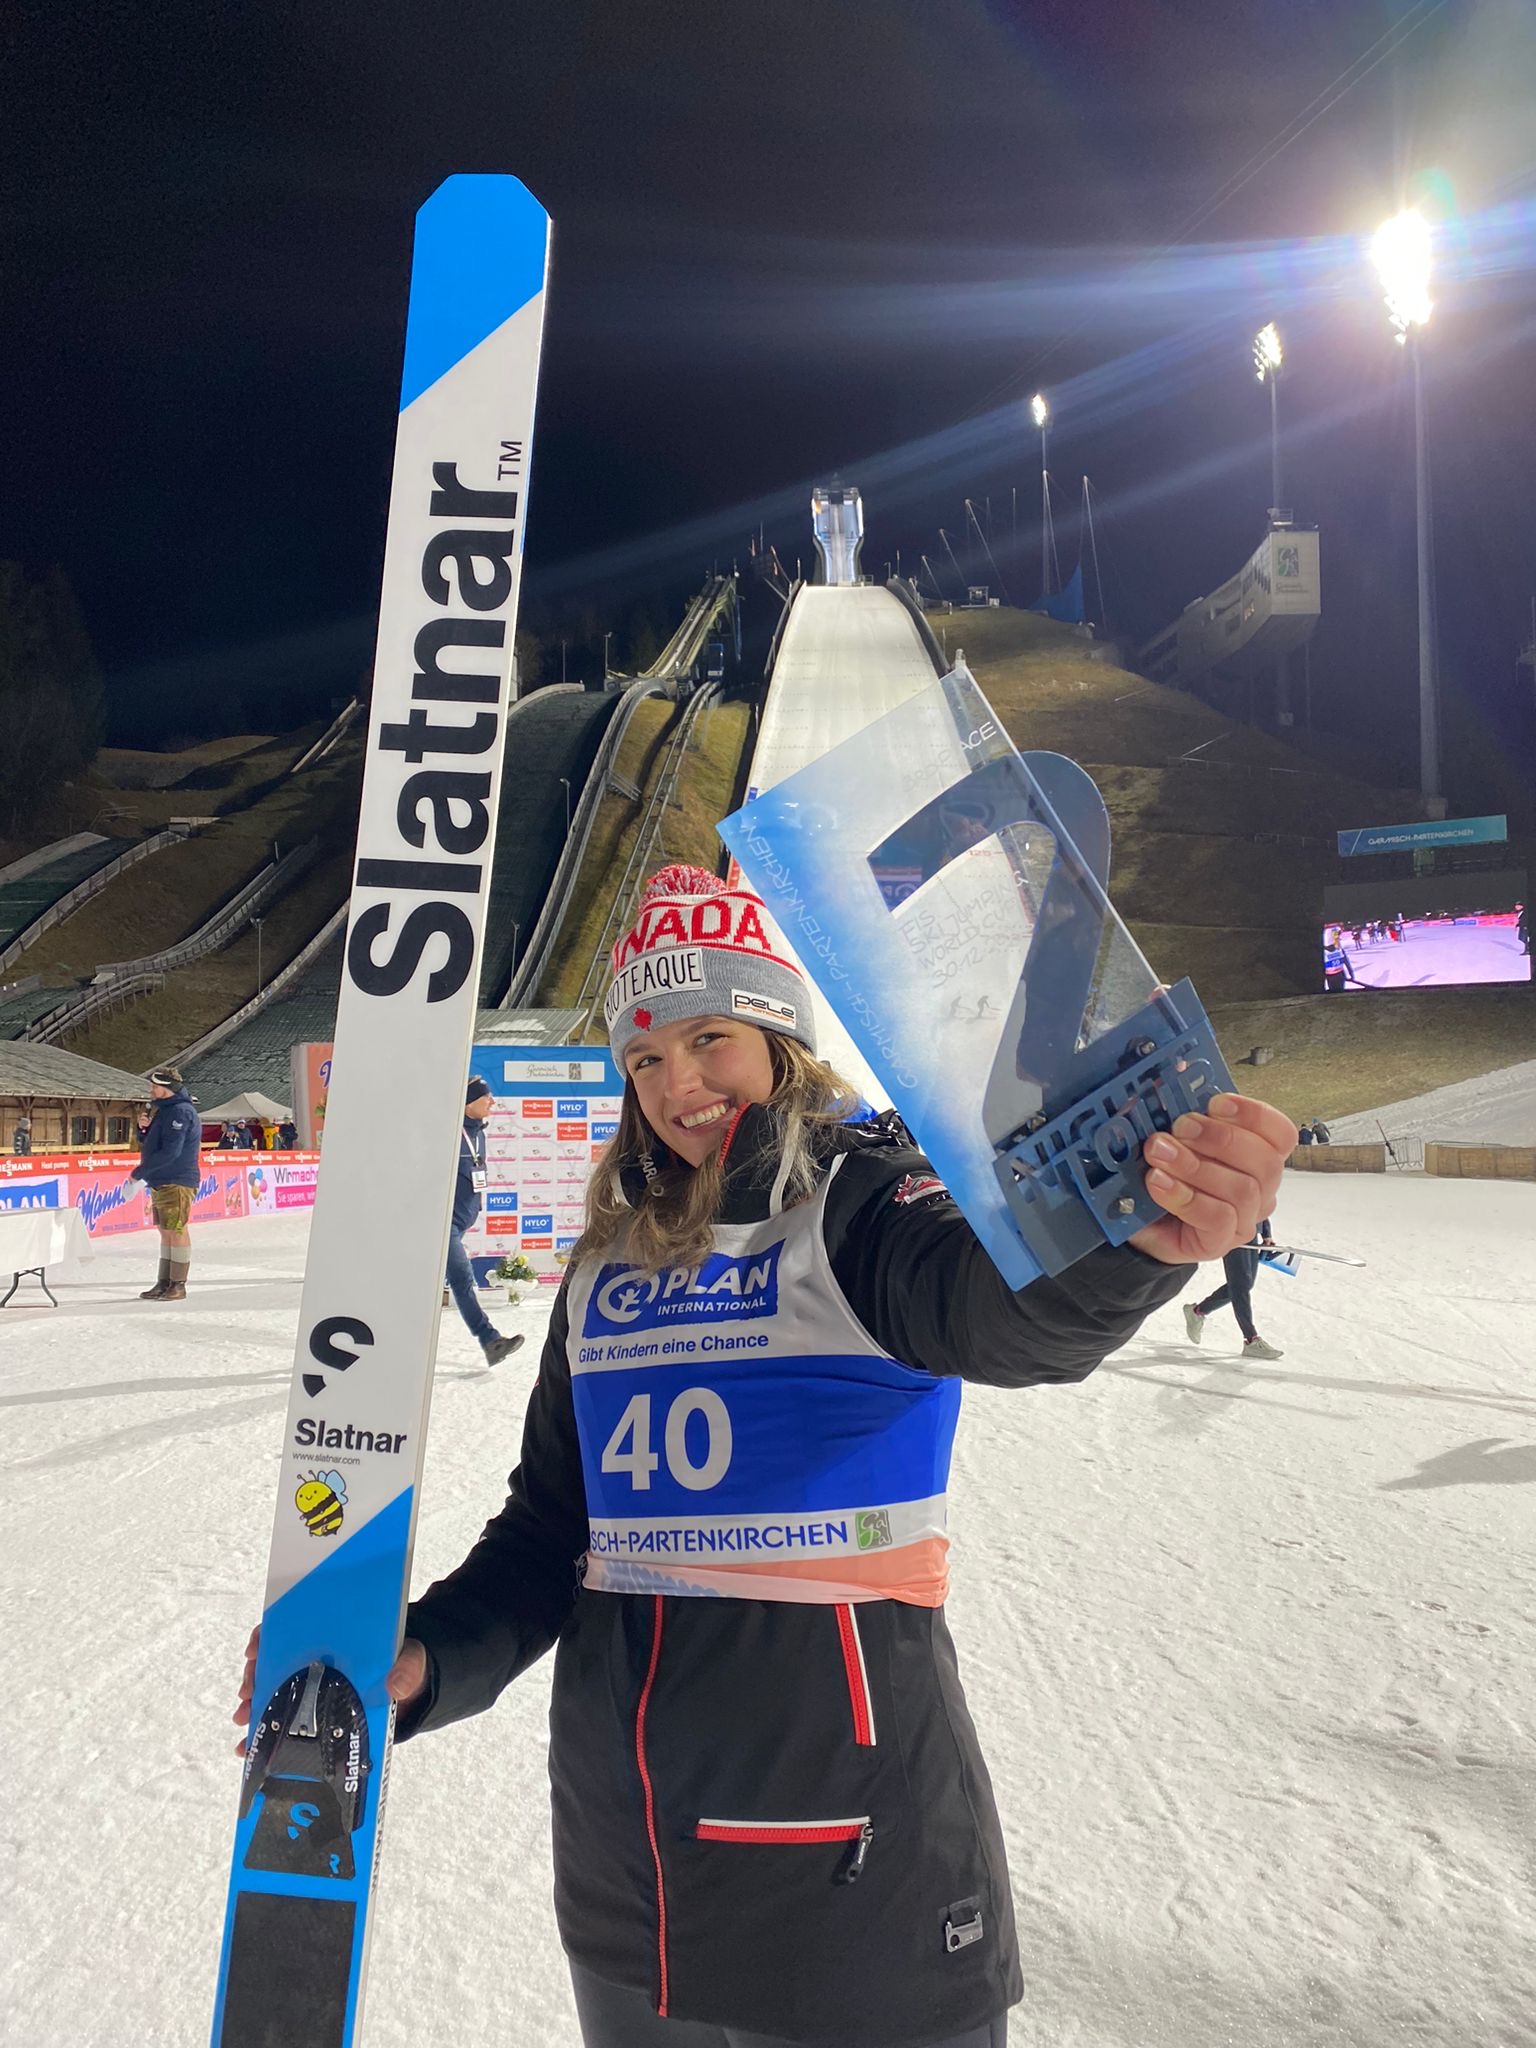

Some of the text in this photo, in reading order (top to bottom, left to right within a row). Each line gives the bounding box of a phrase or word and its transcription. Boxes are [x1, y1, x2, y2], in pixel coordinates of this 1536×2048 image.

[497, 440, 523, 481] TM
[347, 461, 518, 1004] Slatnar
[938, 721, 997, 763] PACE
[613, 899, 772, 975] NADA
[899, 909, 937, 943] FIS
[919, 925, 981, 969] WORLD
[560, 1103, 582, 1111] HYLO
[524, 1219, 547, 1227] HYLO
[661, 1257, 771, 1299] PLAN
[657, 1295, 767, 1316] INTERNATIONAL
[578, 1334, 769, 1364] Gibt Kindern eine Chance
[294, 1418, 407, 1454] Slatnar
[601, 1386, 732, 1492] 40
[292, 1451, 361, 1465] www.slatnar.com
[344, 1730, 360, 1794] Slatnar
[371, 1696, 397, 1896] www.Slatnar.co
